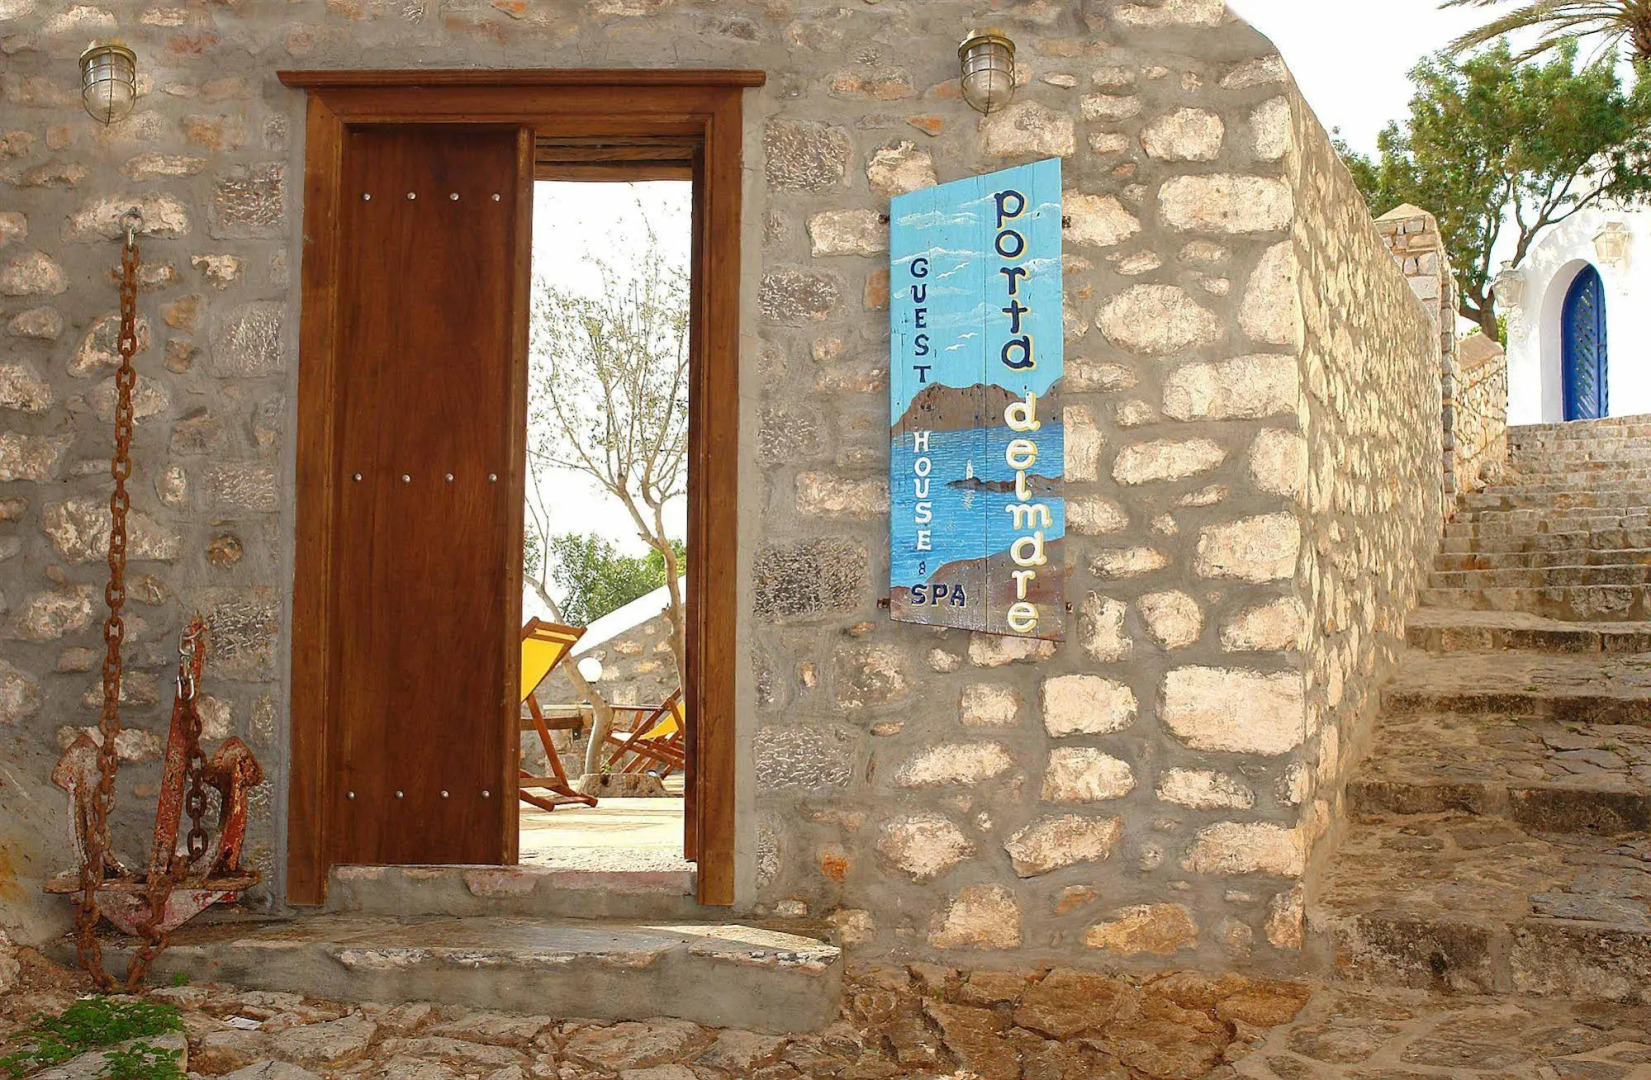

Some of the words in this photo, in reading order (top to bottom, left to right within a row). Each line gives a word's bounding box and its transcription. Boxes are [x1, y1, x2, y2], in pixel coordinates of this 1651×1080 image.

[910, 257, 932, 383] GUEST
[913, 430, 933, 551] HOUSE
[911, 583, 967, 607] SPA
